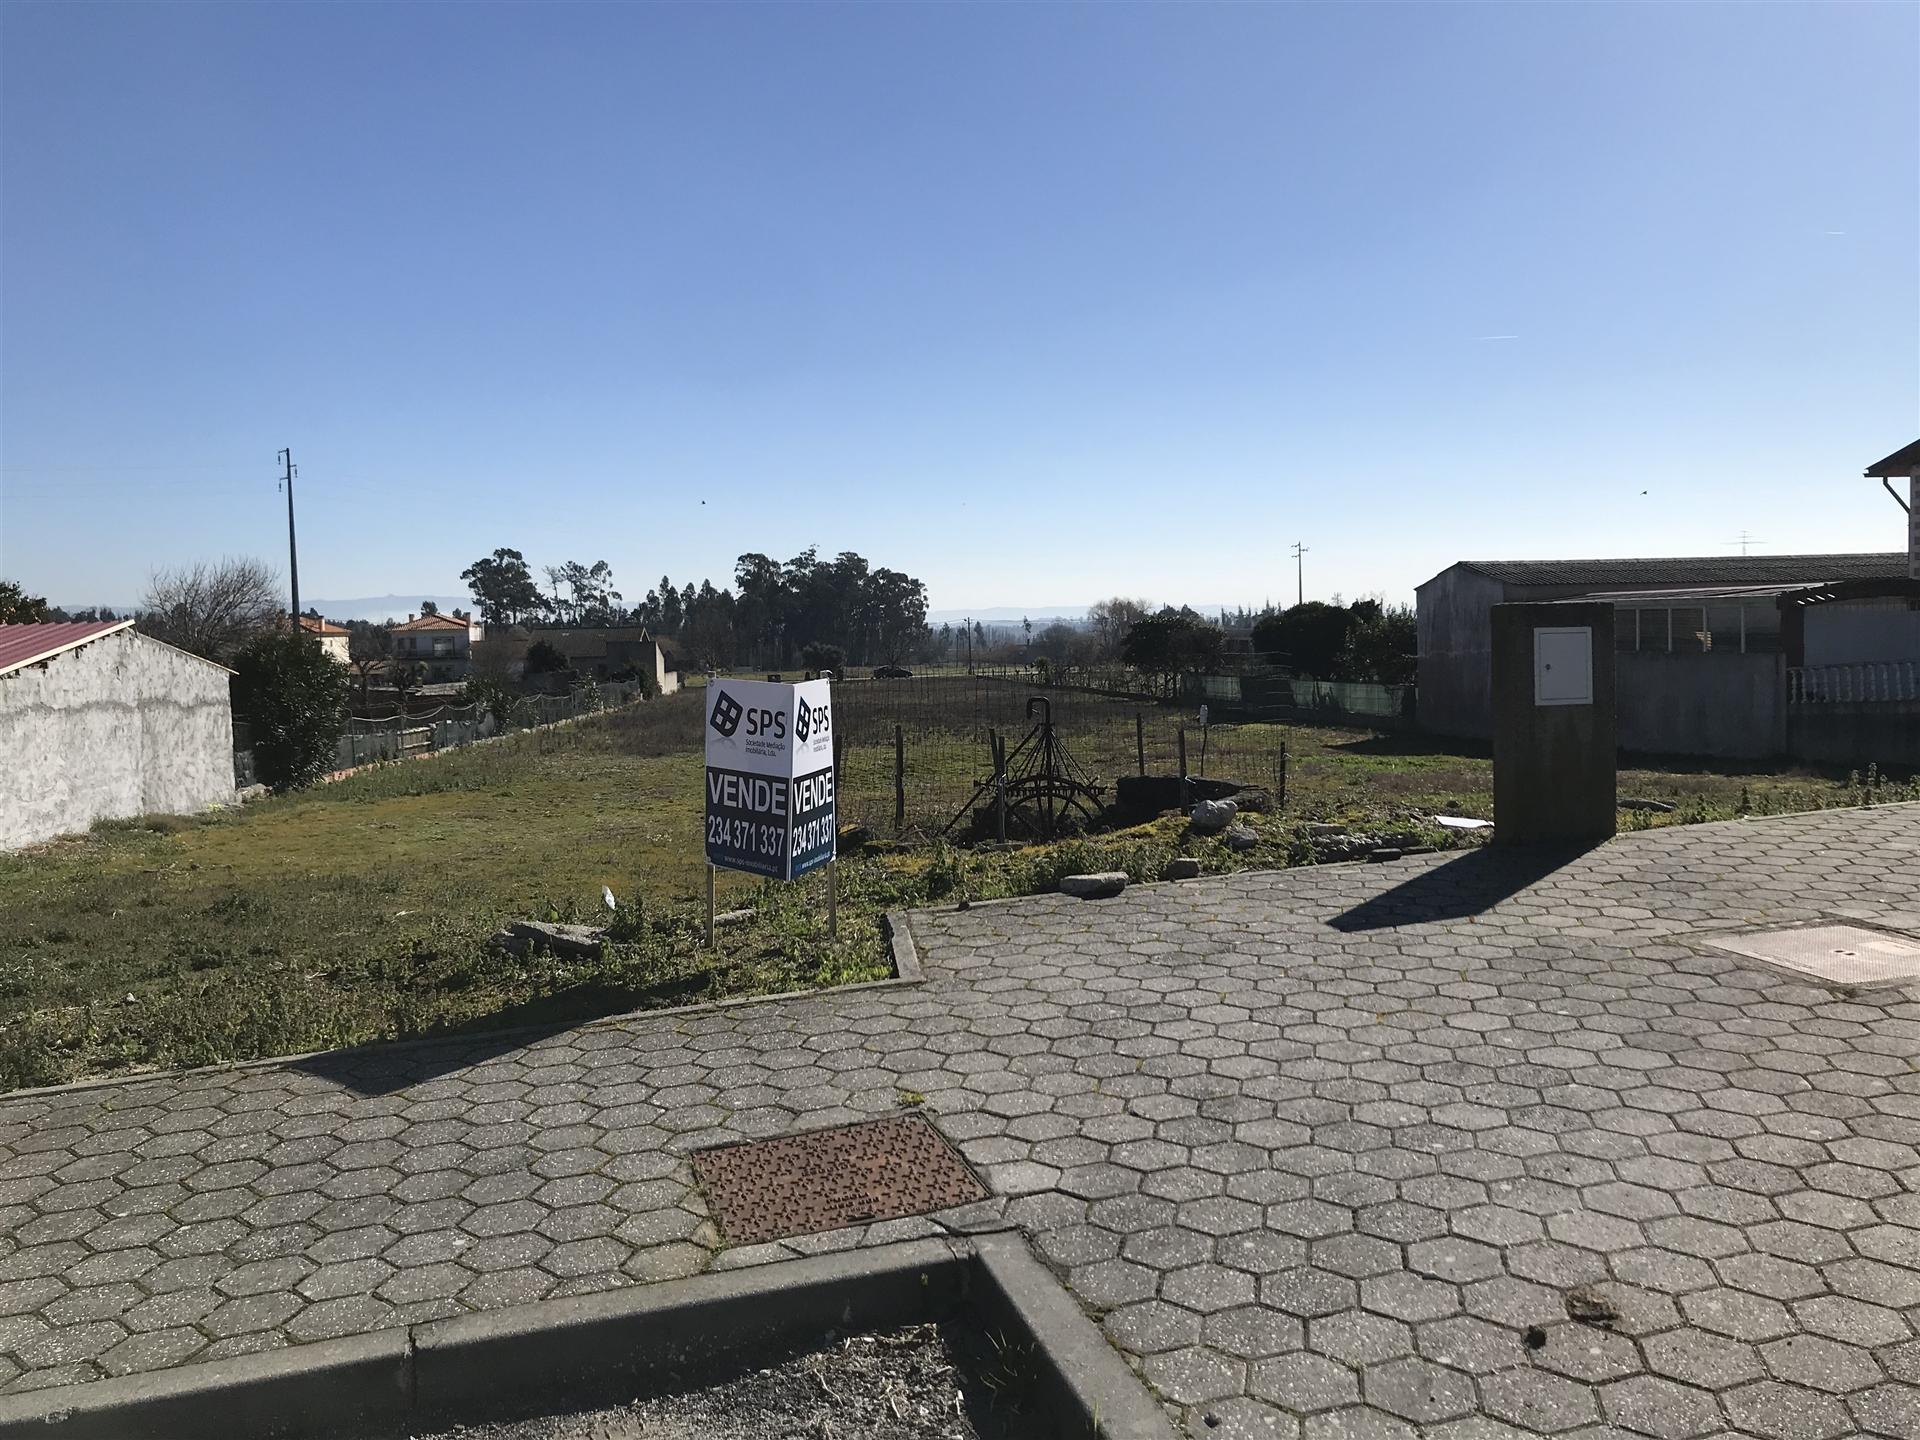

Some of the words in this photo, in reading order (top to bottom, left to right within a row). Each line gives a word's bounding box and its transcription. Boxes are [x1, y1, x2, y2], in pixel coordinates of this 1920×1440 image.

[746, 707, 786, 739] SPS
[812, 705, 829, 735] SPS
[708, 772, 787, 816] VENDE
[794, 771, 833, 815] VENDE
[708, 815, 731, 847] 234
[733, 820, 756, 851] 371
[760, 825, 785, 857] 337
[792, 823, 807, 858] 234
[807, 818, 820, 851] 371
[820, 813, 833, 845] 337
